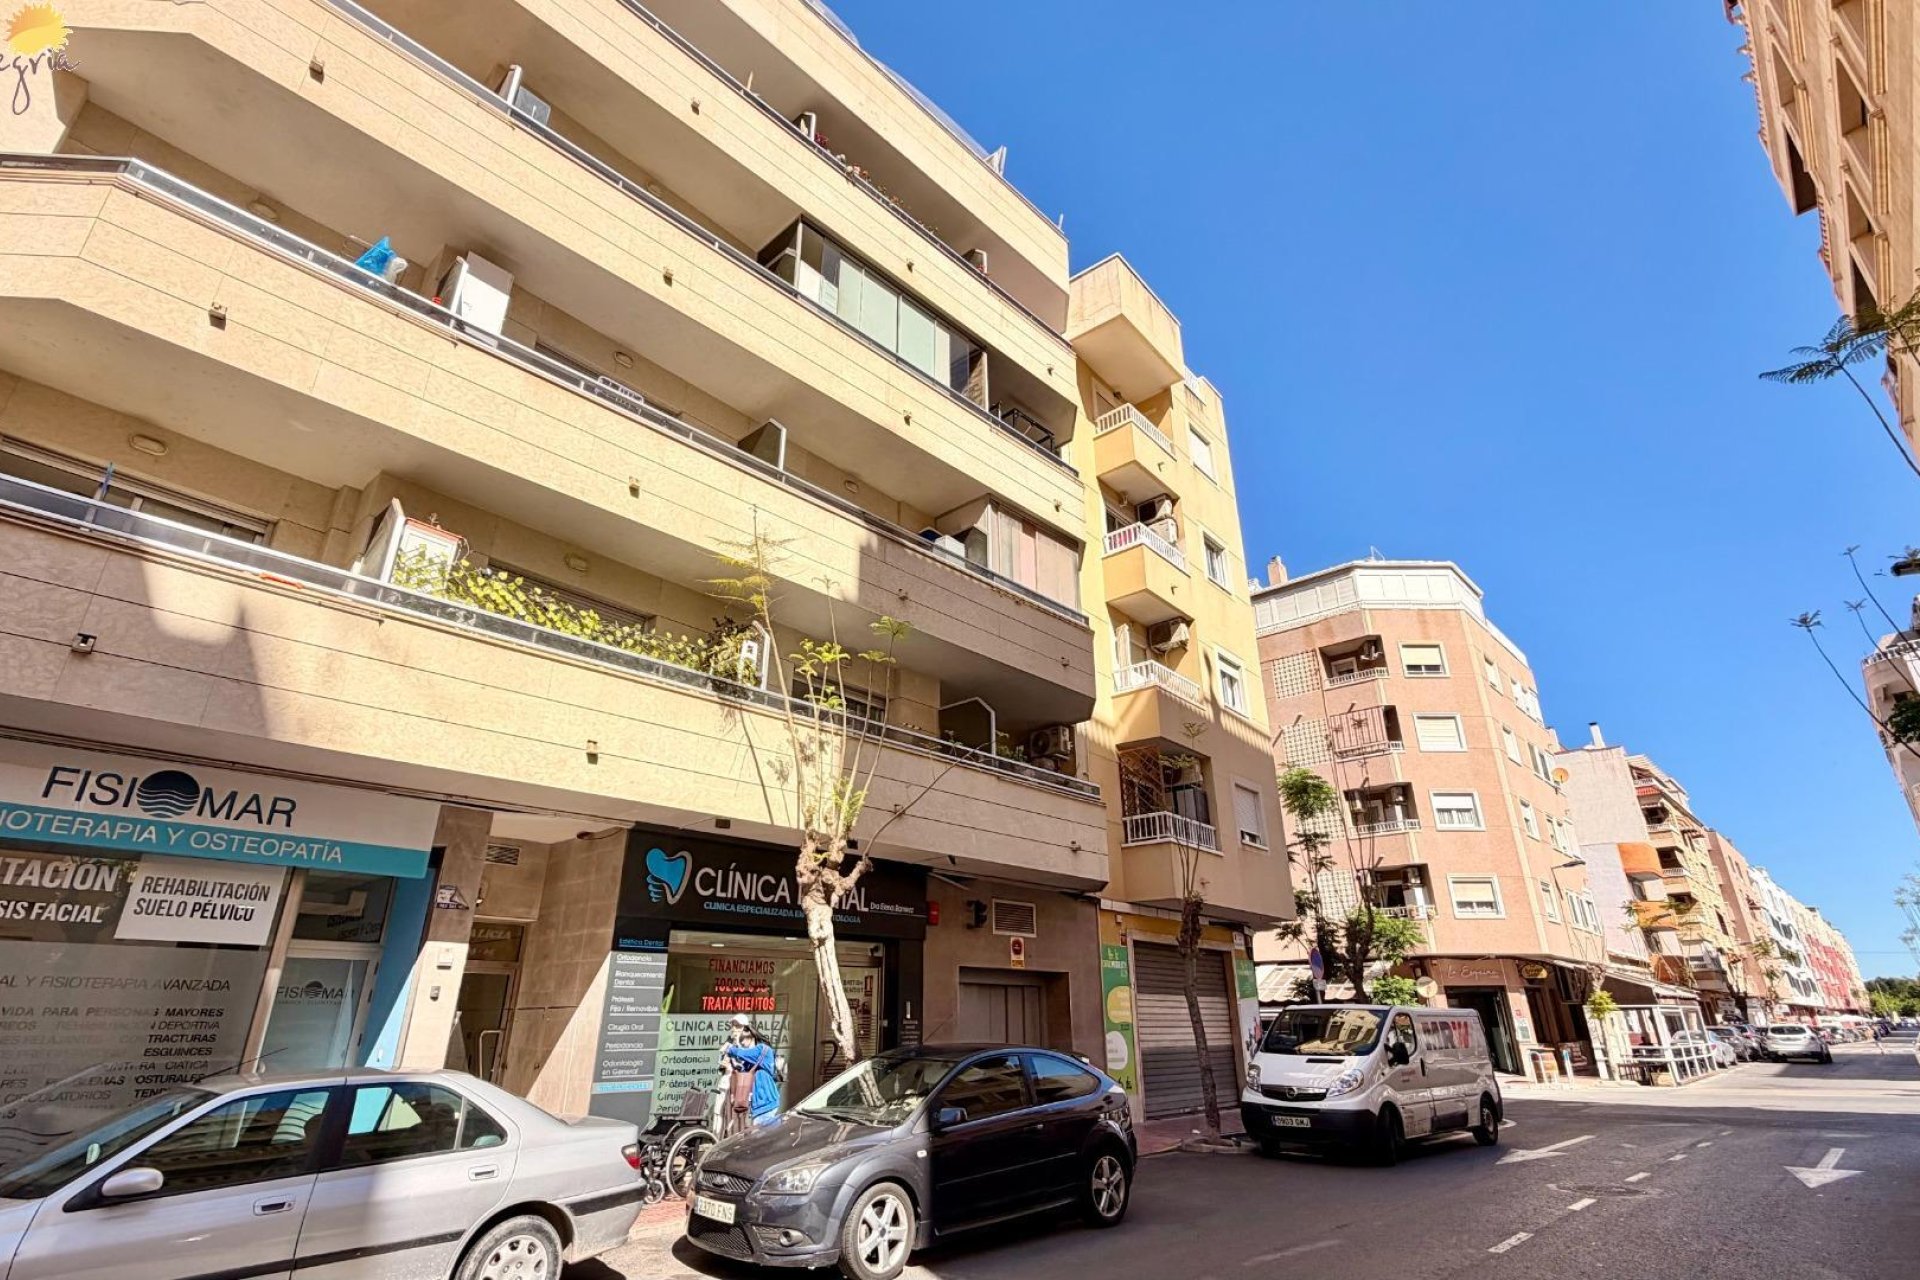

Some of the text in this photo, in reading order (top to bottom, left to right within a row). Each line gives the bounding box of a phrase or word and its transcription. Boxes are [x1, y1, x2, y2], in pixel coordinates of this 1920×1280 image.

[166, 826, 185, 846] Y
[189, 831, 343, 864] OSTEOPATÍA
[140, 875, 271, 902] REHABILITACIÓN
[694, 862, 791, 906] CLÍNICA
[29, 901, 105, 923] FACIAL
[133, 897, 187, 917] SUELO
[709, 958, 776, 975] FINANCIAMOS
[1, 1006, 35, 1017] VIDA
[41, 1006, 80, 1017] PARA
[164, 1007, 225, 1018] MAYORES
[666, 1019, 714, 1032] CLINICA
[678, 1035, 696, 1047] EN
[143, 1046, 213, 1057] ESGUINCES
[661, 1054, 711, 1065] Ortodoncia
